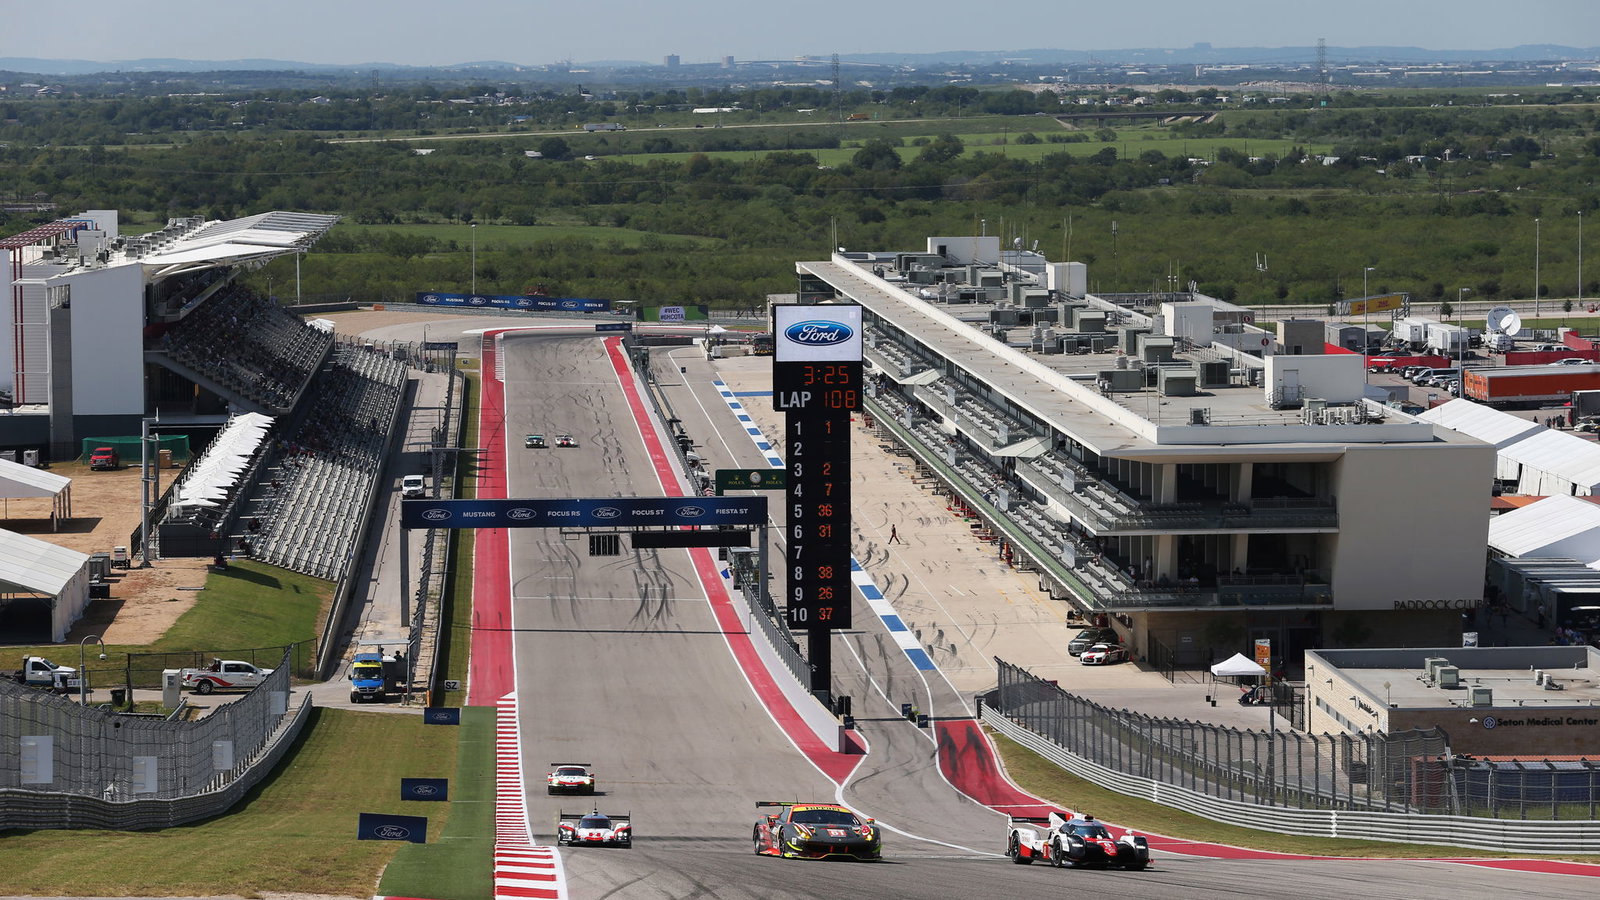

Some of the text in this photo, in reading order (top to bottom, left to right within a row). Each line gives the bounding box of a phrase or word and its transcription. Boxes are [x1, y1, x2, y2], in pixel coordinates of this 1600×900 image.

[799, 324, 838, 341] Ford
[804, 366, 849, 384] 3:25
[780, 390, 856, 408] LAP 108
[794, 422, 832, 435] 1 1
[794, 442, 803, 456] 2
[794, 463, 831, 477] 3 2
[794, 484, 833, 497] 4 7
[794, 504, 833, 518] 5 36
[794, 525, 832, 539] 6 31
[794, 546, 803, 560] 7
[794, 566, 833, 580] 8 38
[794, 587, 833, 601] 9 26
[1393, 600, 1452, 611] PADDOCK
[790, 607, 833, 622] 10 37
[445, 681, 458, 690] SZ
[1497, 716, 1598, 726] Seton Medical Center
